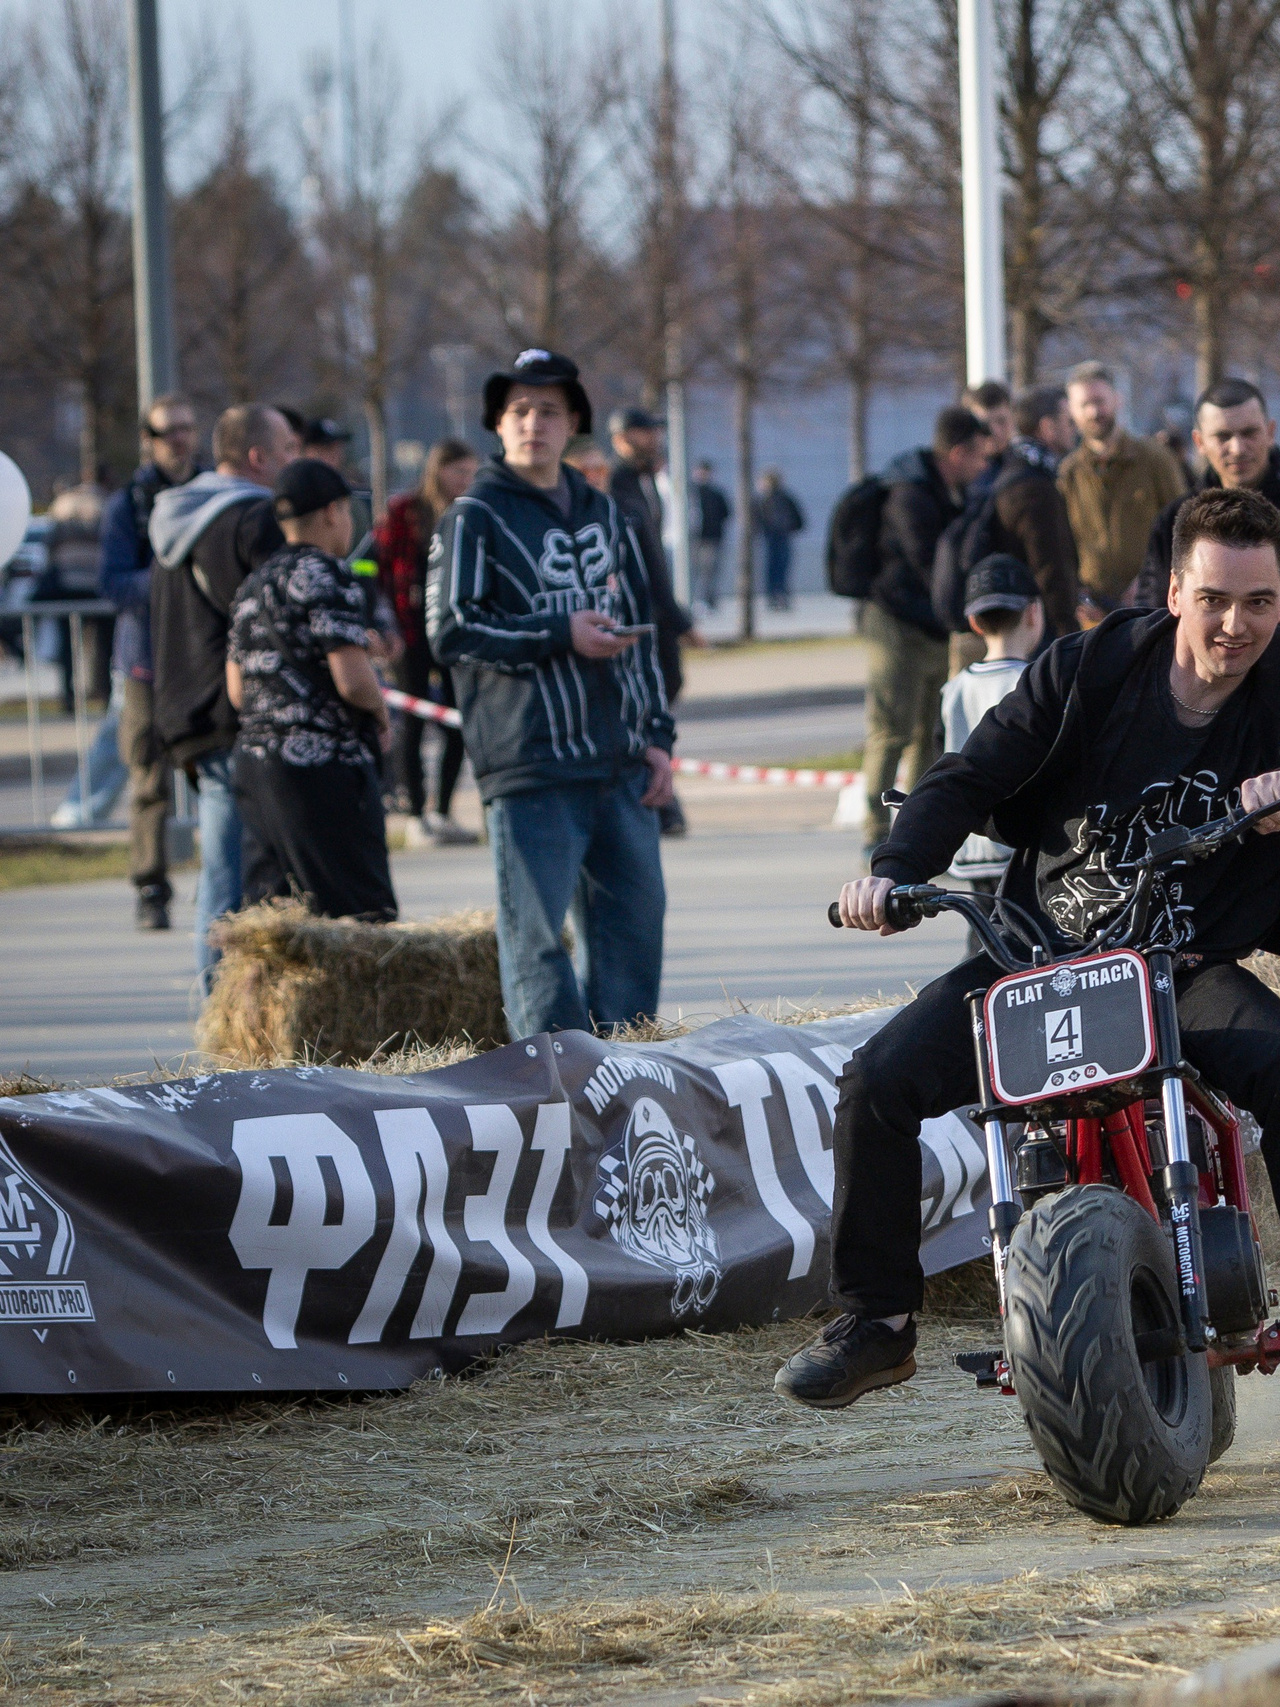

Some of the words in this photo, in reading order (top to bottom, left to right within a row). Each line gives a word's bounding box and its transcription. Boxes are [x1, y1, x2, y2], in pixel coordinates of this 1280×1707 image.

[1006, 983, 1044, 1008] FLAT
[1078, 961, 1135, 990] TRACK
[1050, 1009, 1079, 1050] 4
[228, 1102, 589, 1349] ФЛЭТ
[0, 1289, 86, 1315] OTORCITY.PRO
